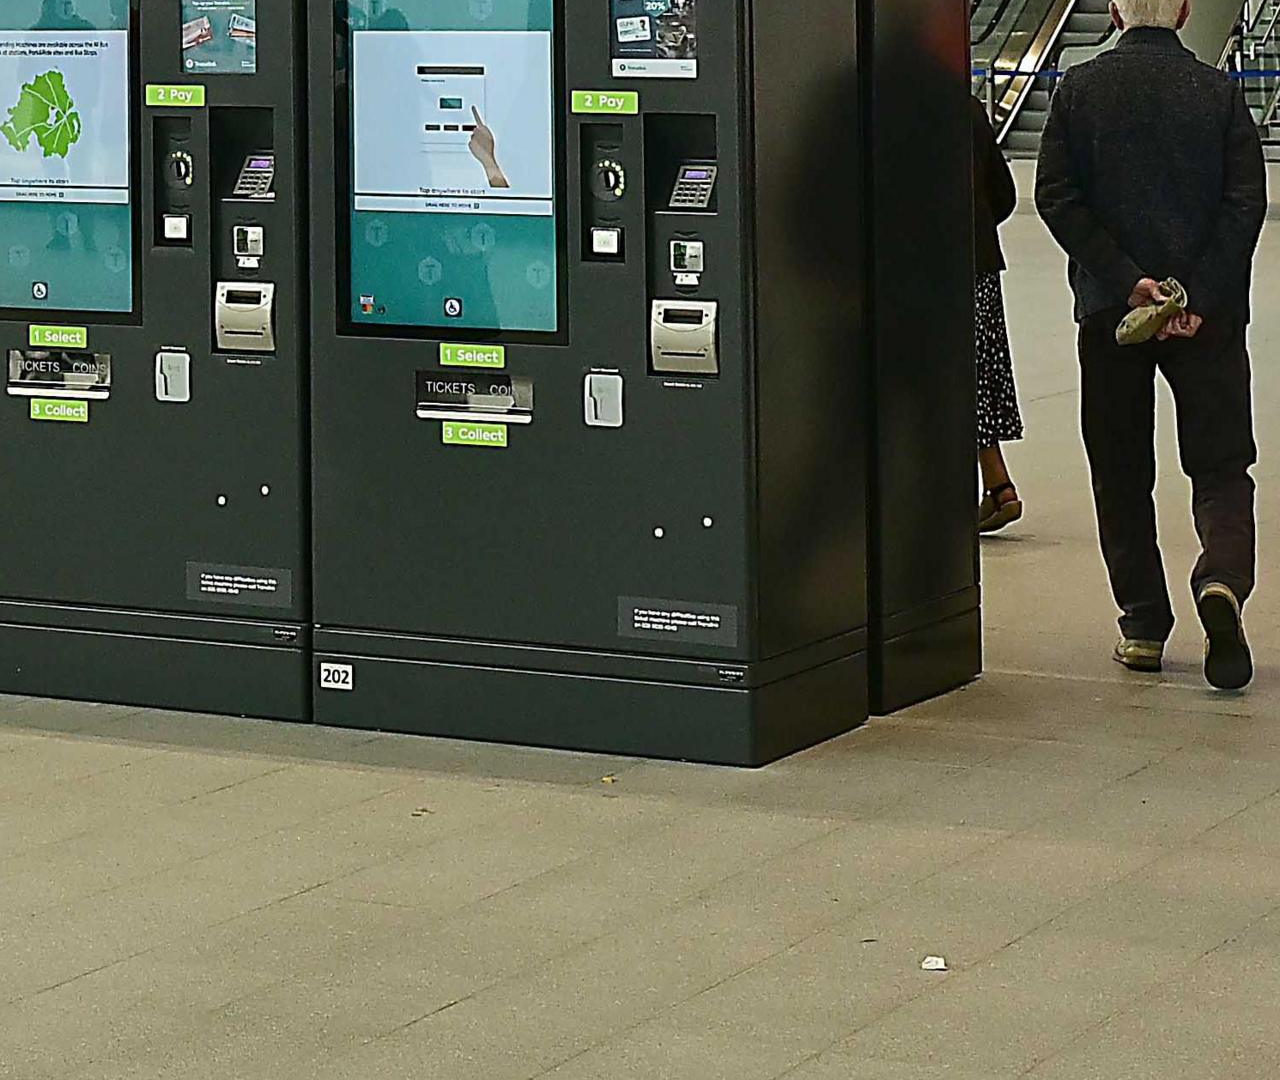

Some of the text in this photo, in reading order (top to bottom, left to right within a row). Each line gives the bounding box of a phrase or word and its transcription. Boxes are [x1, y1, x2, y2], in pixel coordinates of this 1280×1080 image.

[643, 1, 666, 12] 20%
[158, 89, 192, 101] 2 Pay
[584, 95, 624, 109] 2 Pay
[34, 329, 82, 344] 1 Select
[445, 348, 499, 363] 1 Select
[72, 363, 106, 374] COINS
[426, 381, 475, 395] TICKETS
[33, 405, 85, 417] 3 Collect
[446, 428, 503, 442] 3 Collect
[323, 668, 350, 685] 202
